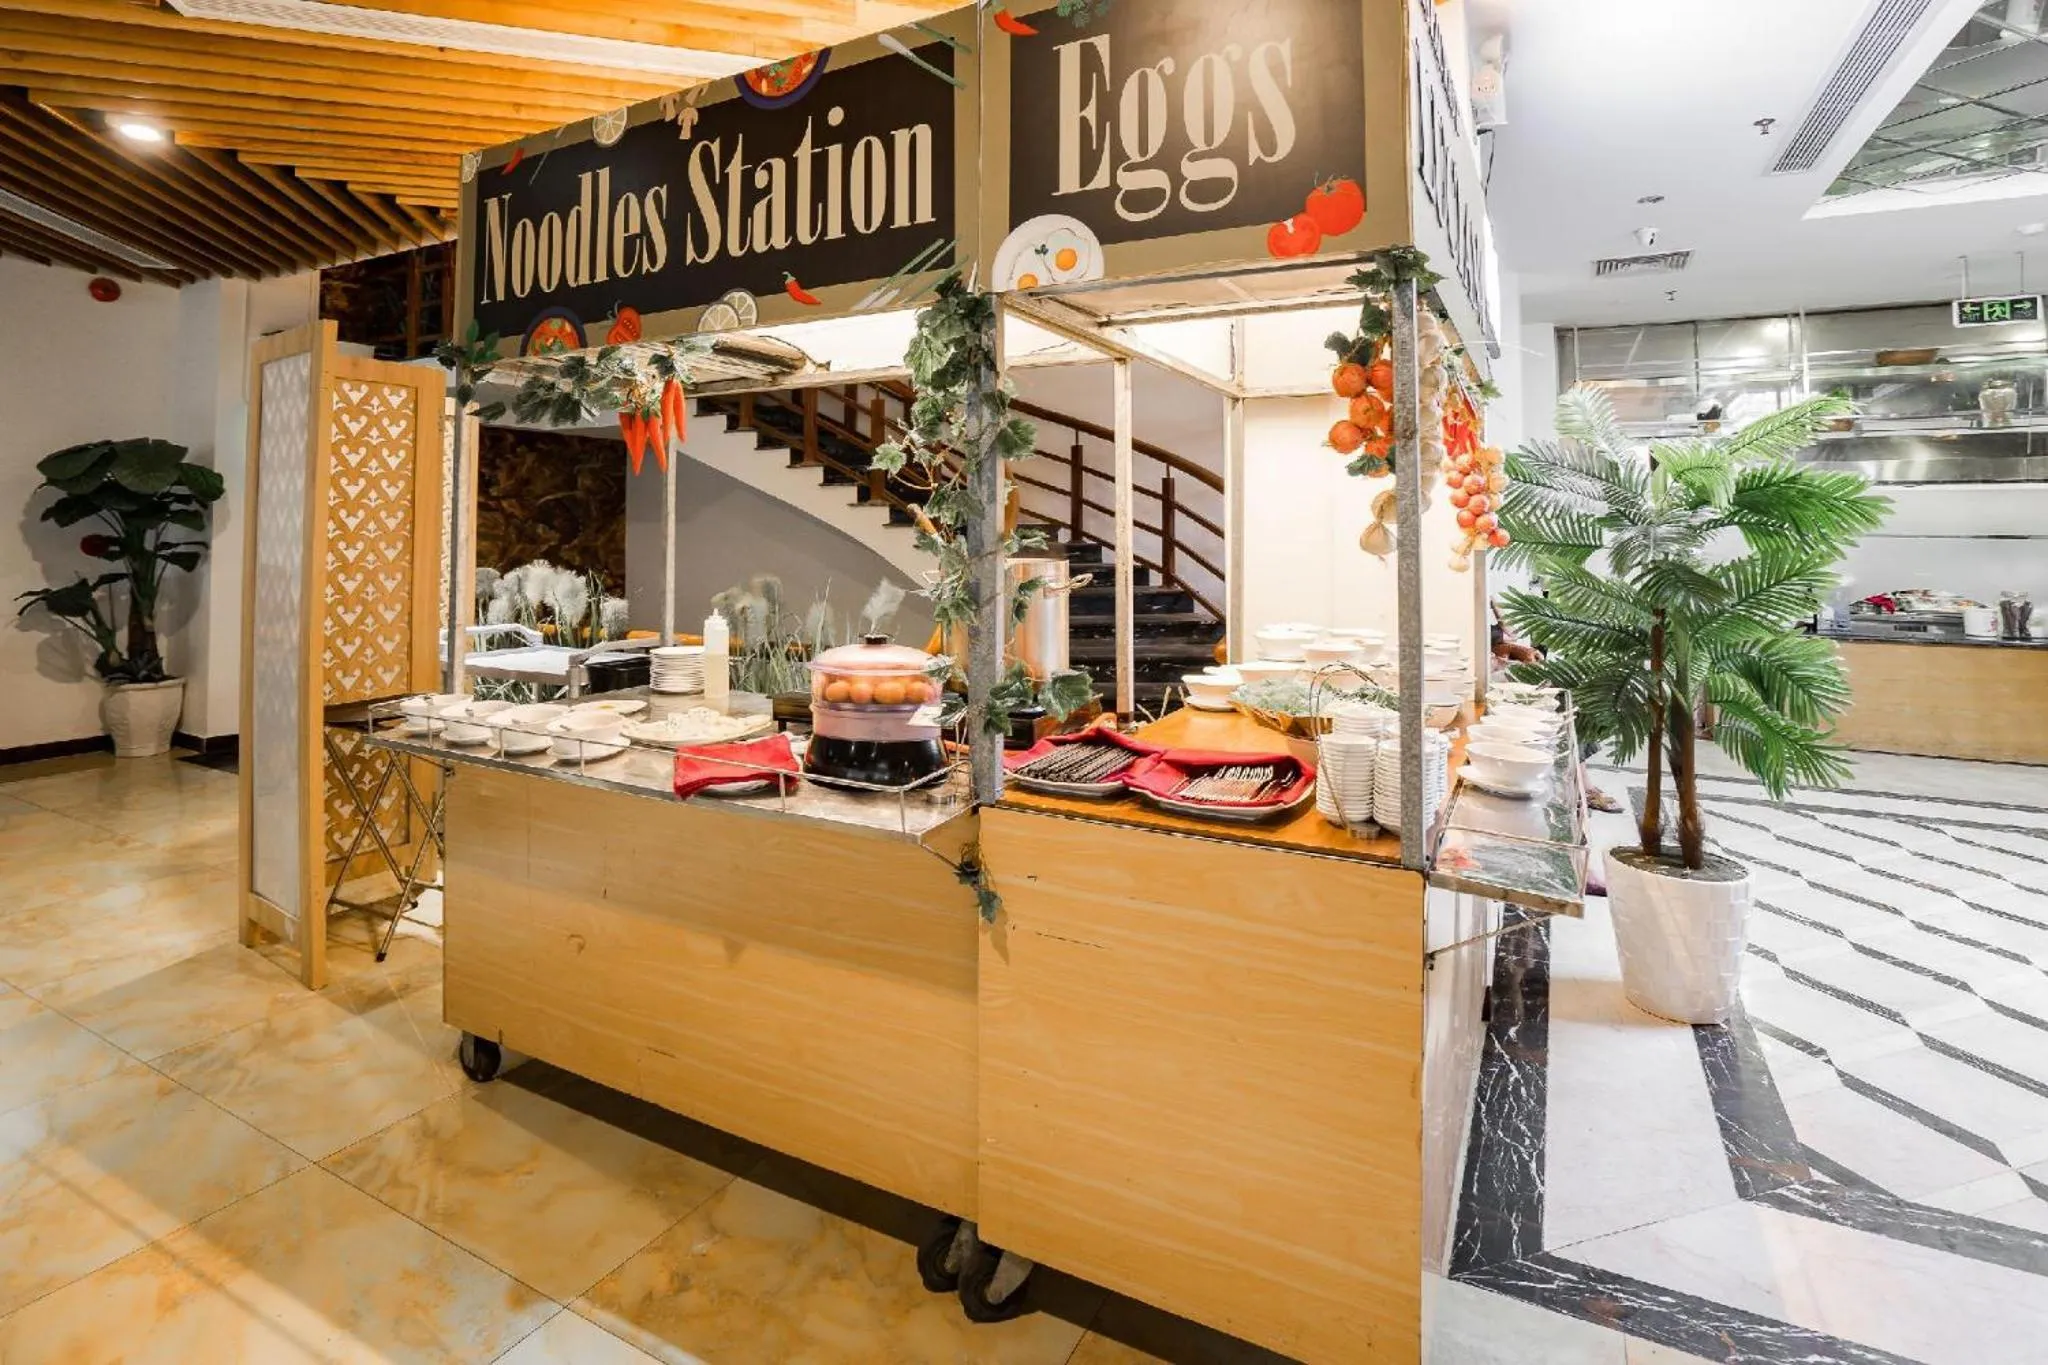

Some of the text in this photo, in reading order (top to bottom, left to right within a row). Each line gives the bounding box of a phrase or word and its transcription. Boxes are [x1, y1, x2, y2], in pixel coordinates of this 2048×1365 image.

[480, 106, 937, 305] Noodles Station
[1051, 34, 1296, 222] Eggs
